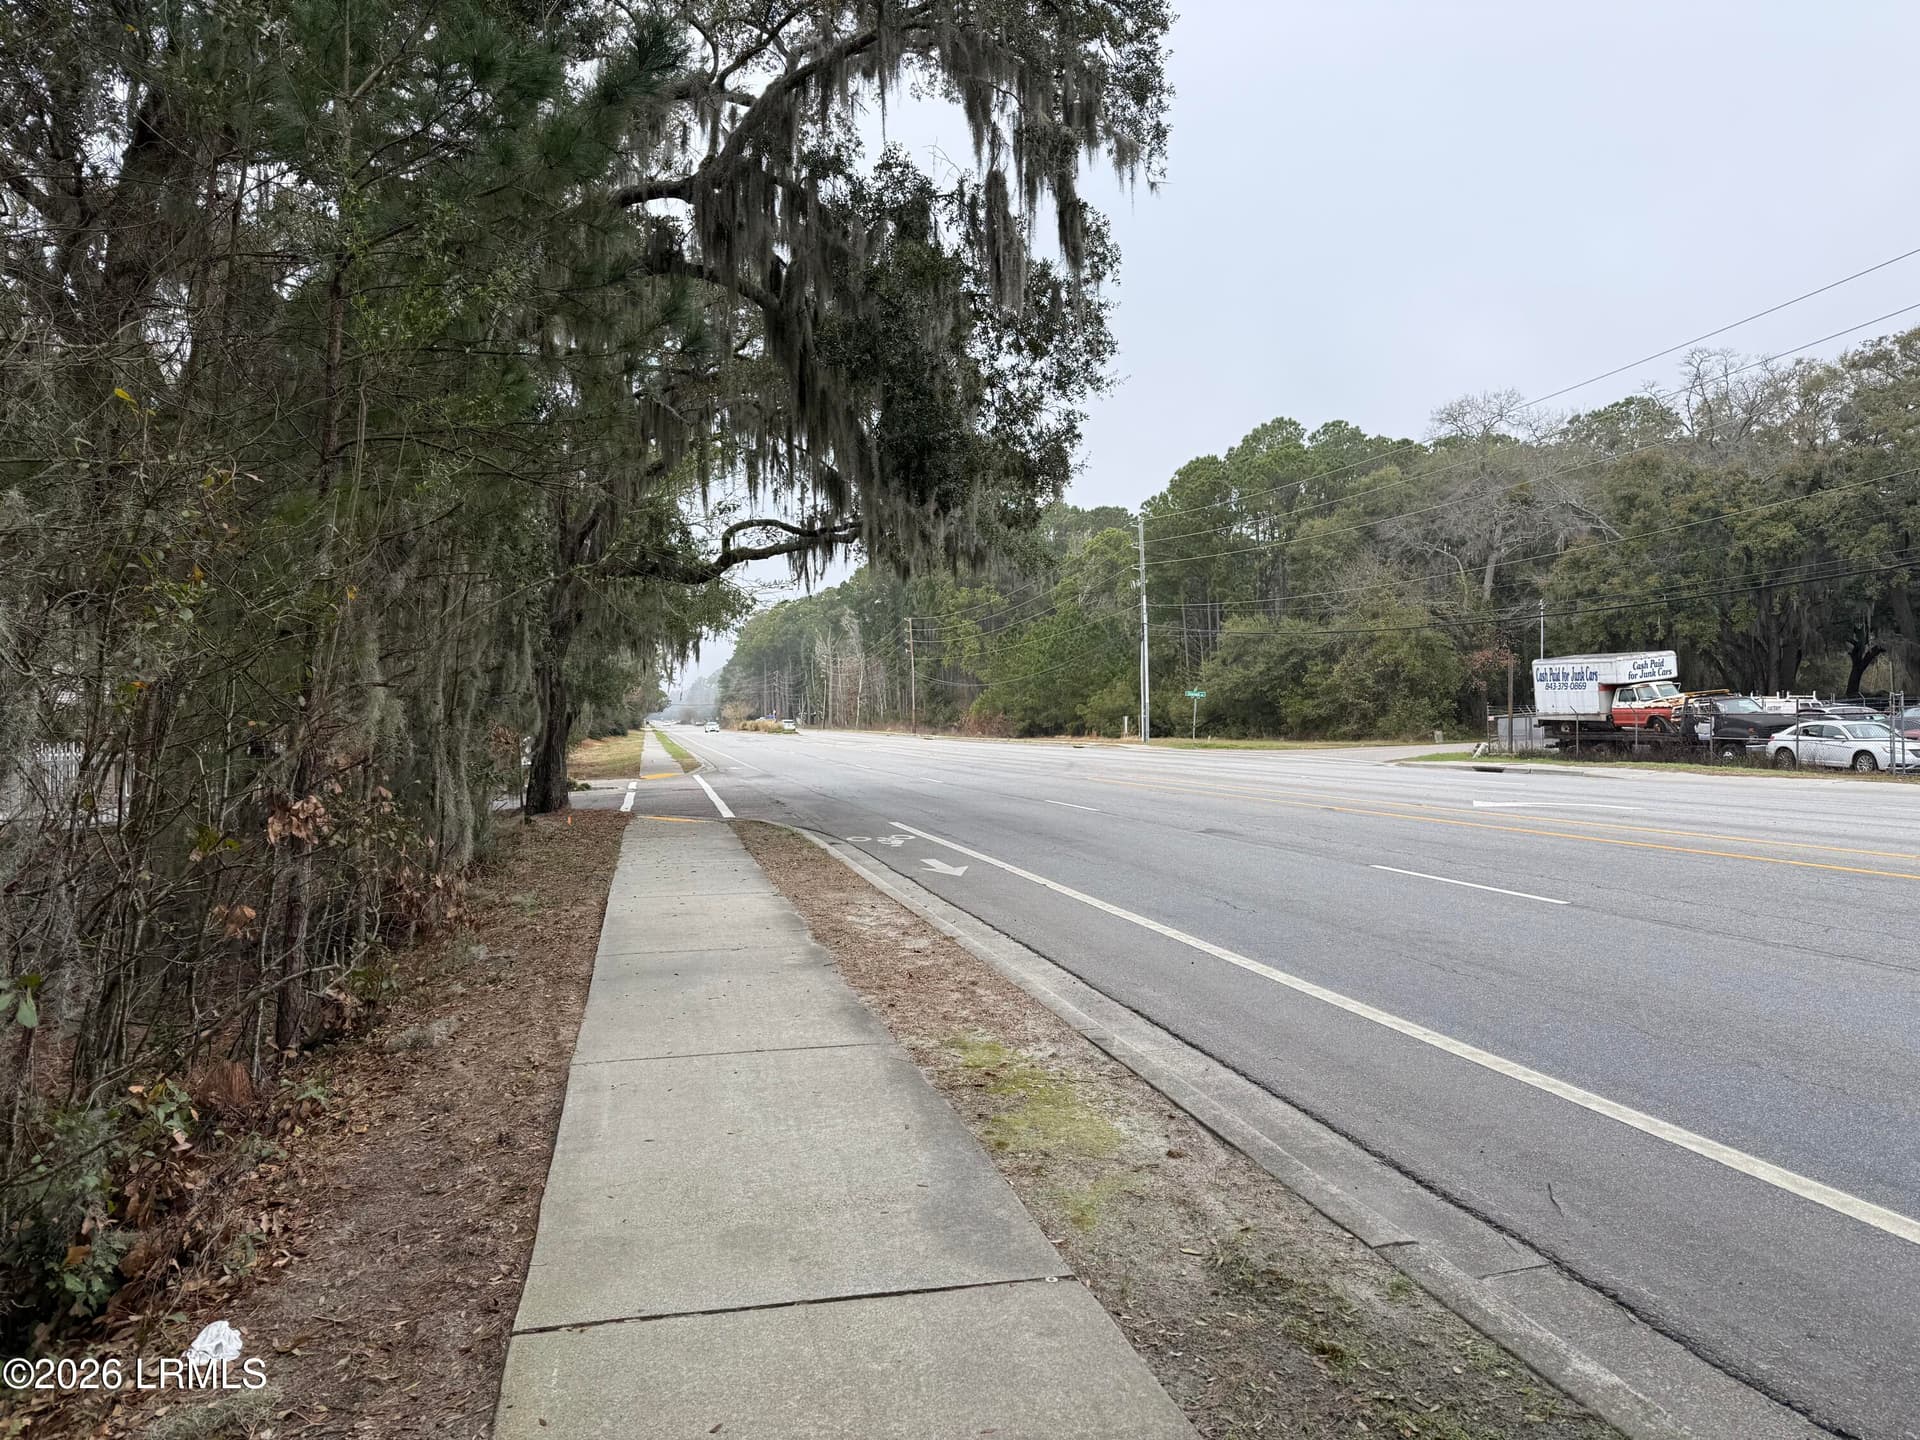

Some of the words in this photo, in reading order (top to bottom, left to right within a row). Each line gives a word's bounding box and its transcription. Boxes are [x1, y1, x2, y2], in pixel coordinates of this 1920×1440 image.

[1633, 660, 1648, 670] Cash
[1650, 658, 1664, 668] Paid
[1536, 667, 1548, 682] Cash
[1549, 667, 1560, 682] Paid
[1571, 666, 1584, 681] Junk
[1586, 666, 1598, 681] Cars
[1628, 671, 1638, 680] for
[1639, 668, 1656, 678] Junk
[1658, 667, 1672, 676] Cars
